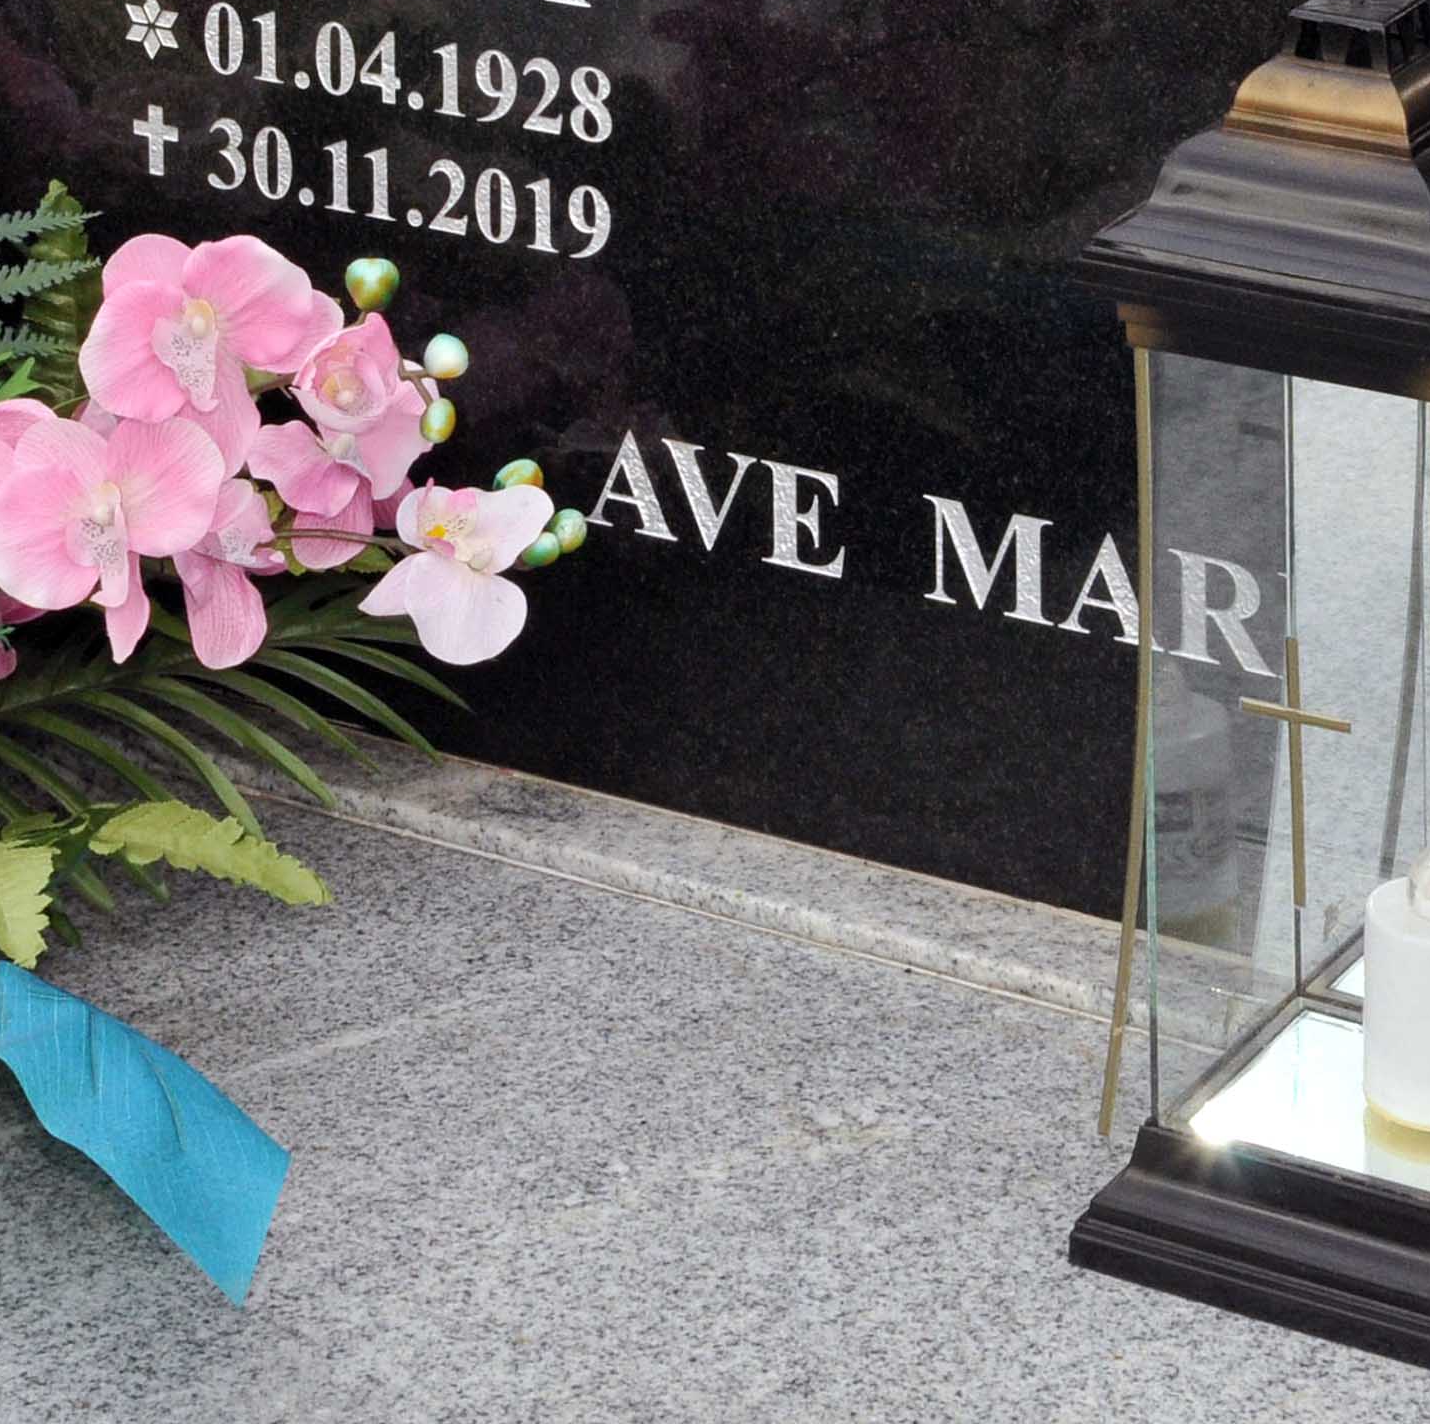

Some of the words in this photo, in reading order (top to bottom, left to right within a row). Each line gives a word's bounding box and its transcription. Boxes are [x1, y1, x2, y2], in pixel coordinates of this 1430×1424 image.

[203, 2, 613, 143] 01.04.1928
[206, 117, 612, 260] 30.11.2019
[587, 428, 846, 579] AVE
[923, 493, 1288, 679] MAR
